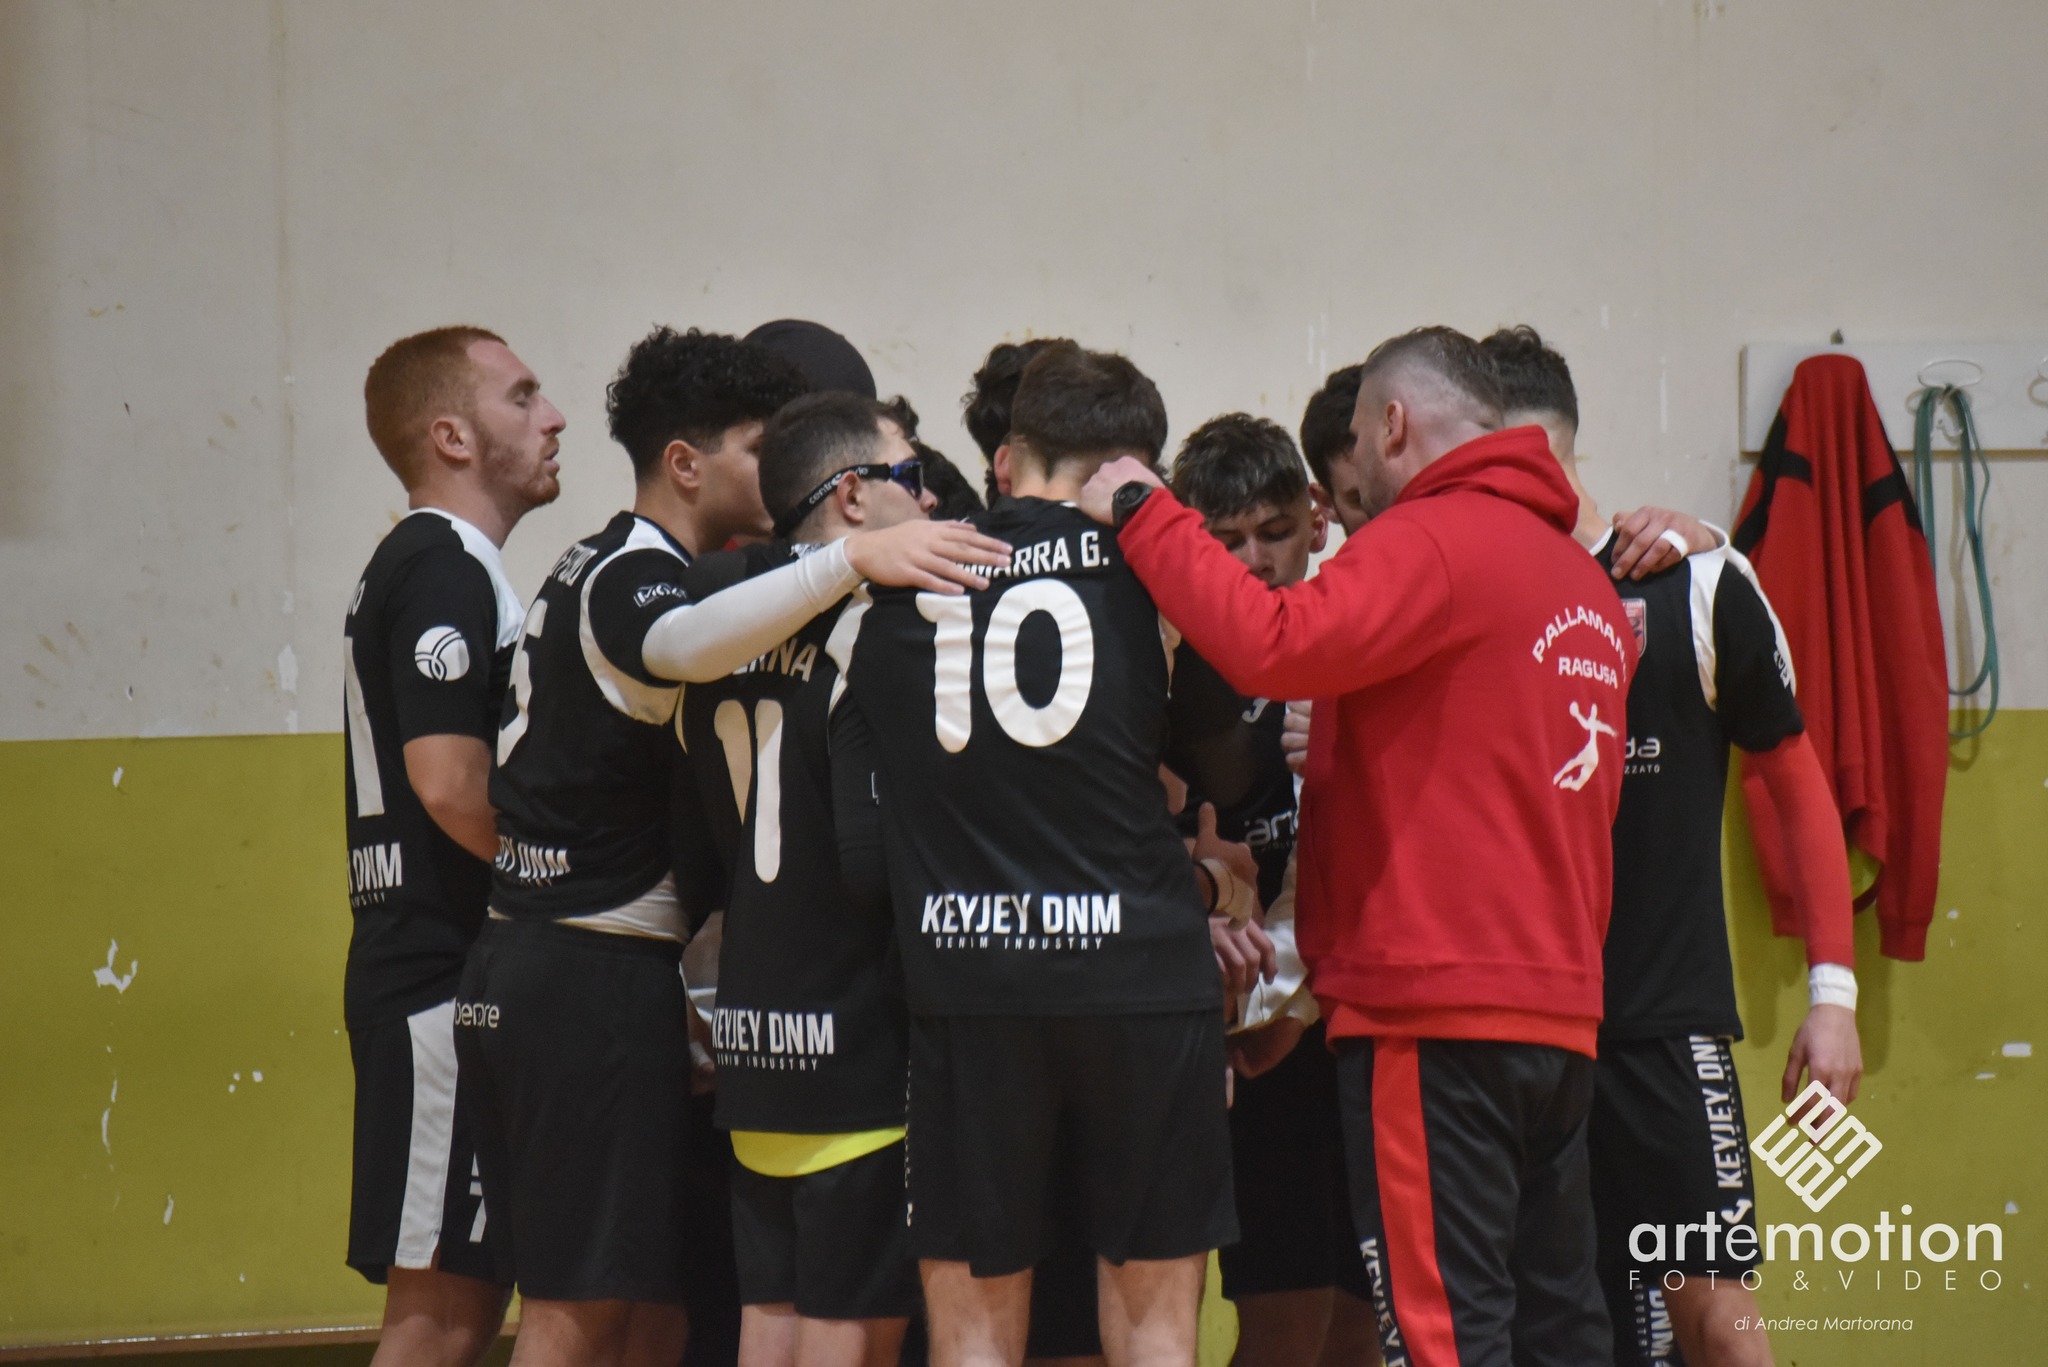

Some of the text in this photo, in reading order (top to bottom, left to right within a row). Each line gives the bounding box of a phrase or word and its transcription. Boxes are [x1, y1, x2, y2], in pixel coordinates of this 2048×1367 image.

[1080, 530, 1110, 568] G.
[915, 578, 1095, 754] 10
[1558, 656, 1618, 690] RAGUSA
[1624, 764, 1661, 775] ZZATO
[713, 698, 784, 883] 11
[352, 842, 403, 893] DNM
[517, 841, 571, 880] DNM
[921, 893, 1121, 935] KEYJEY DNM
[935, 936, 1104, 951] DENIM INDUSTRY
[711, 1007, 834, 1056] KEYJEY DNM
[746, 1055, 818, 1072] INDUSTRY
[1702, 1087, 1744, 1188] KEYJEY
